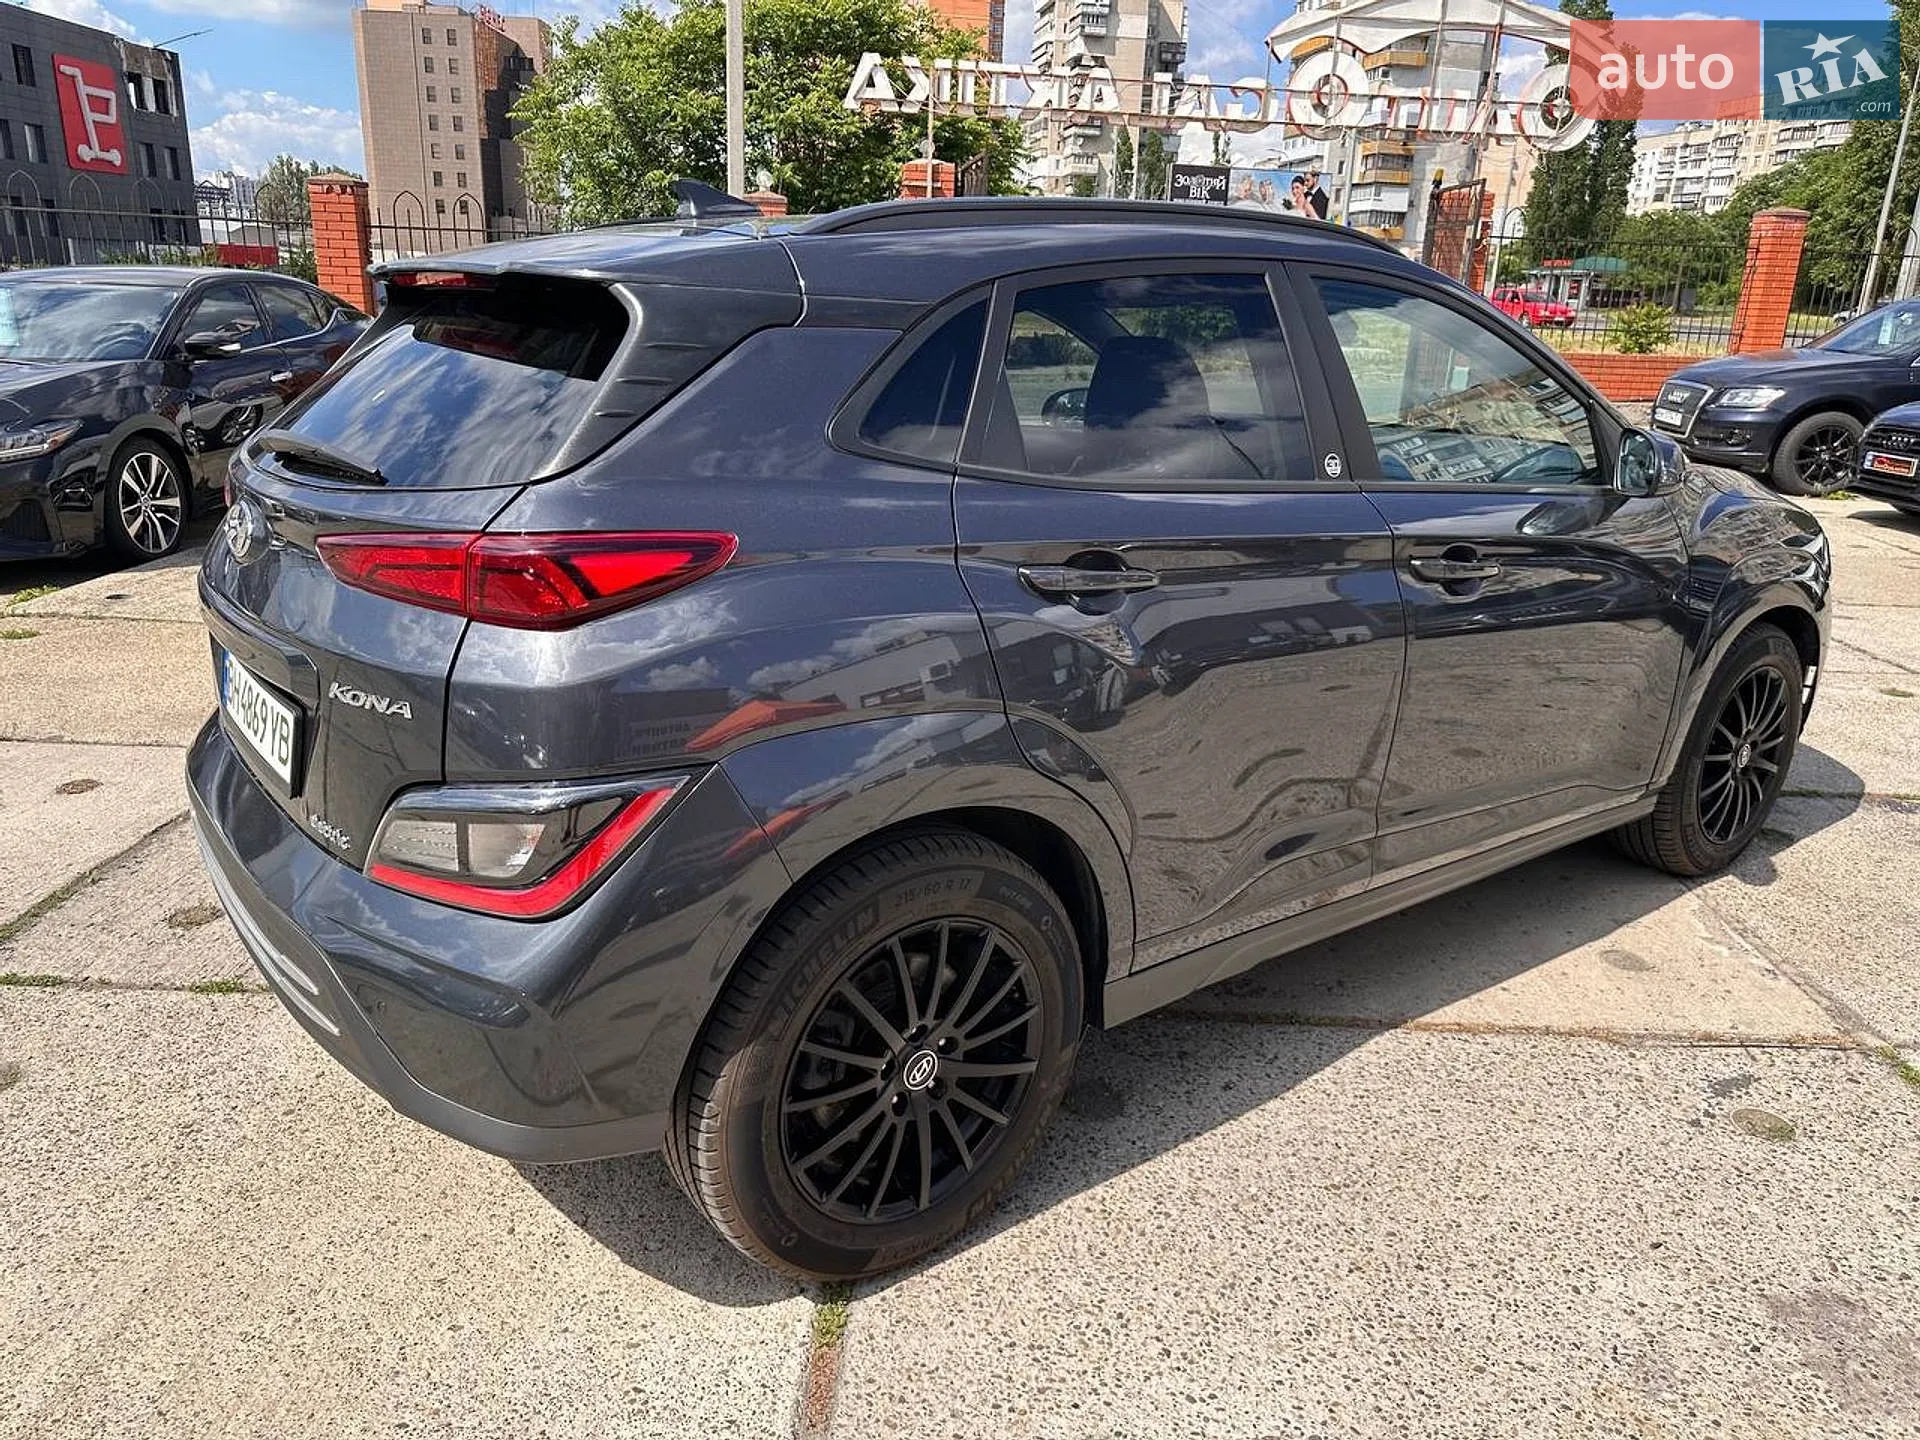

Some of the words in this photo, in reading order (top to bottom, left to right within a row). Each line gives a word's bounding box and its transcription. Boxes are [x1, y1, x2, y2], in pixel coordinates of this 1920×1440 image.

[240, 680, 268, 743] 4869
[270, 706, 291, 766] YB
[328, 682, 413, 719] KONA
